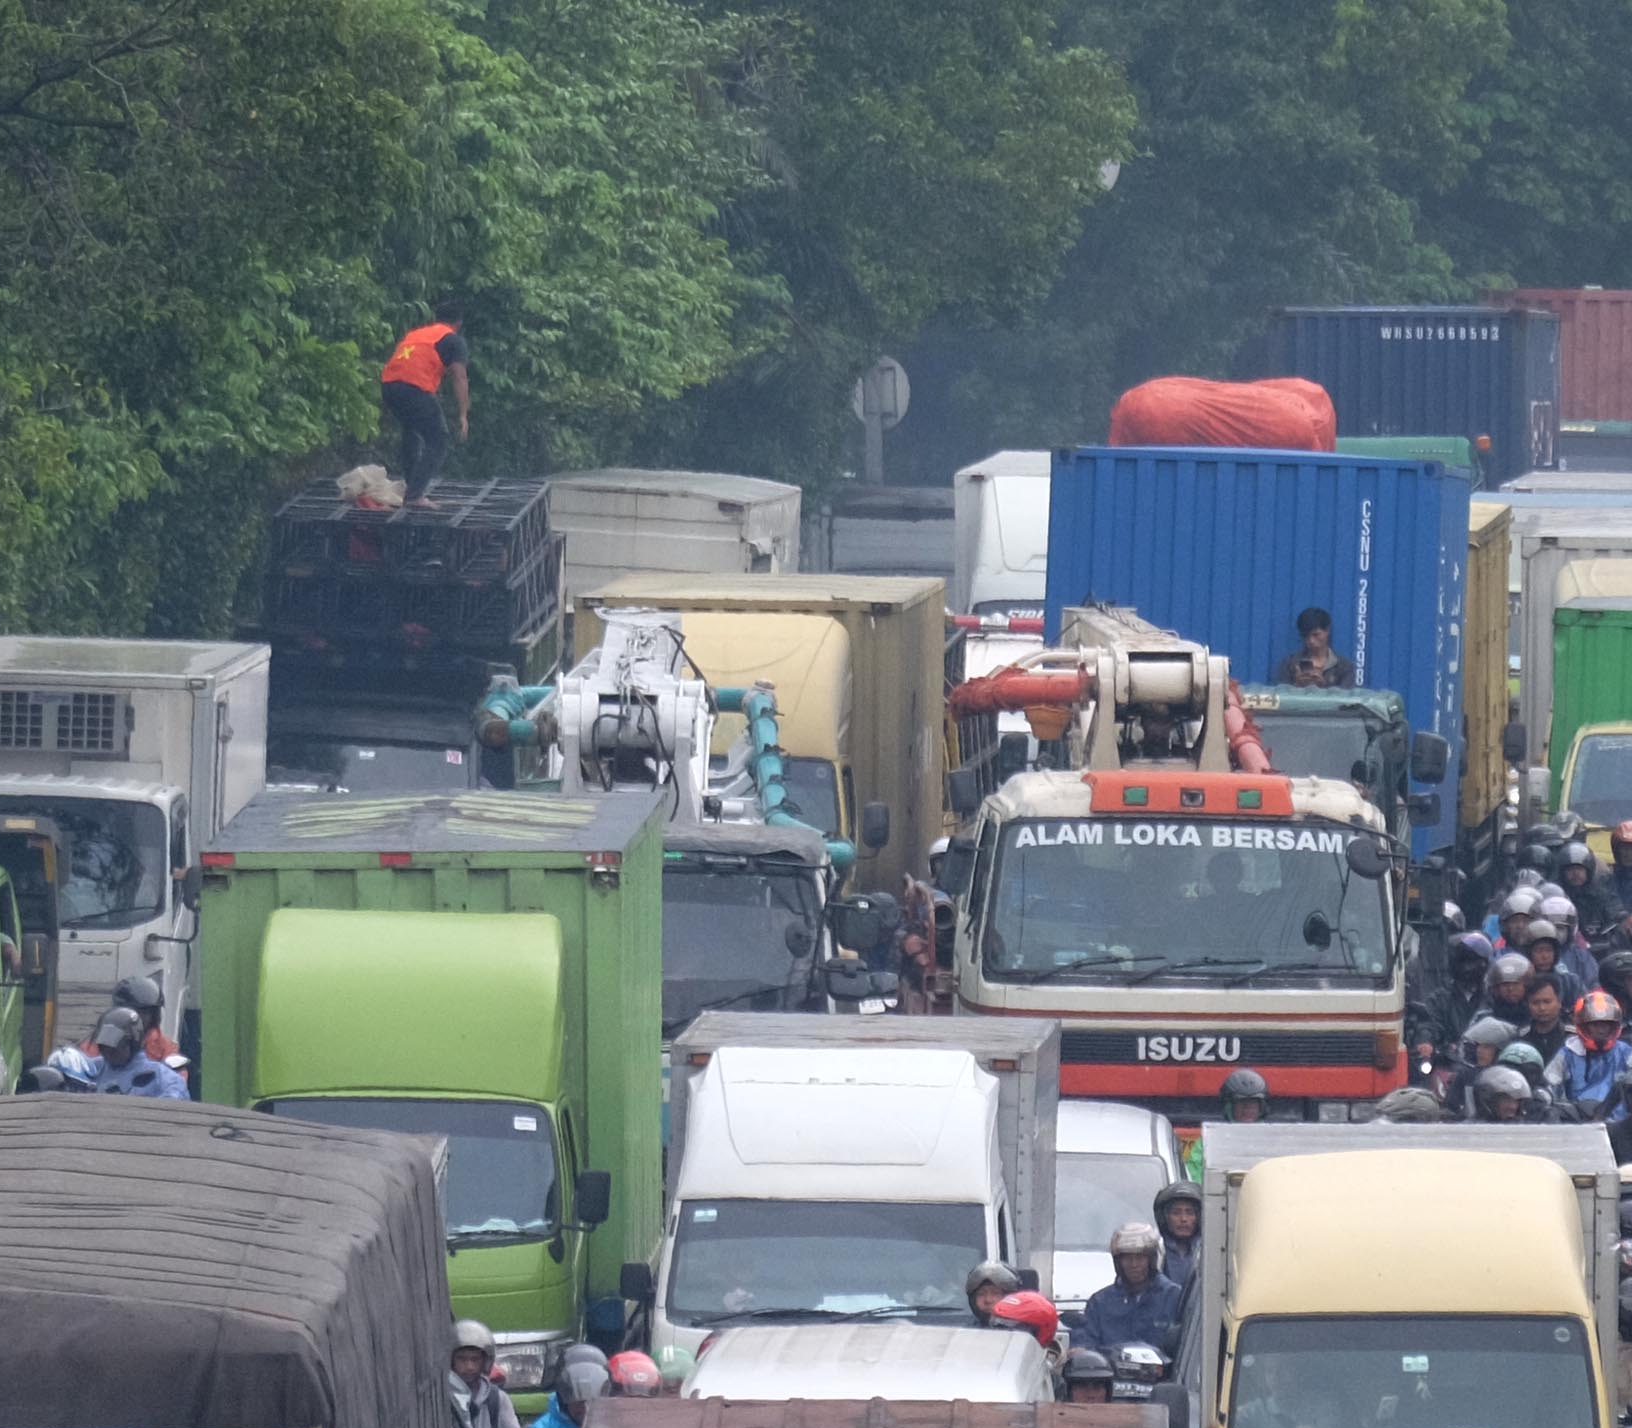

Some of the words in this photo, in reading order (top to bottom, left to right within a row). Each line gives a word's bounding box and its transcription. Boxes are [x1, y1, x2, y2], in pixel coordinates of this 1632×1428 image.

[1016, 824, 1104, 848] ALAM
[1115, 824, 1202, 847] LOKA
[1212, 827, 1359, 853] BERSAM
[1137, 1036, 1241, 1062] ISUZU
